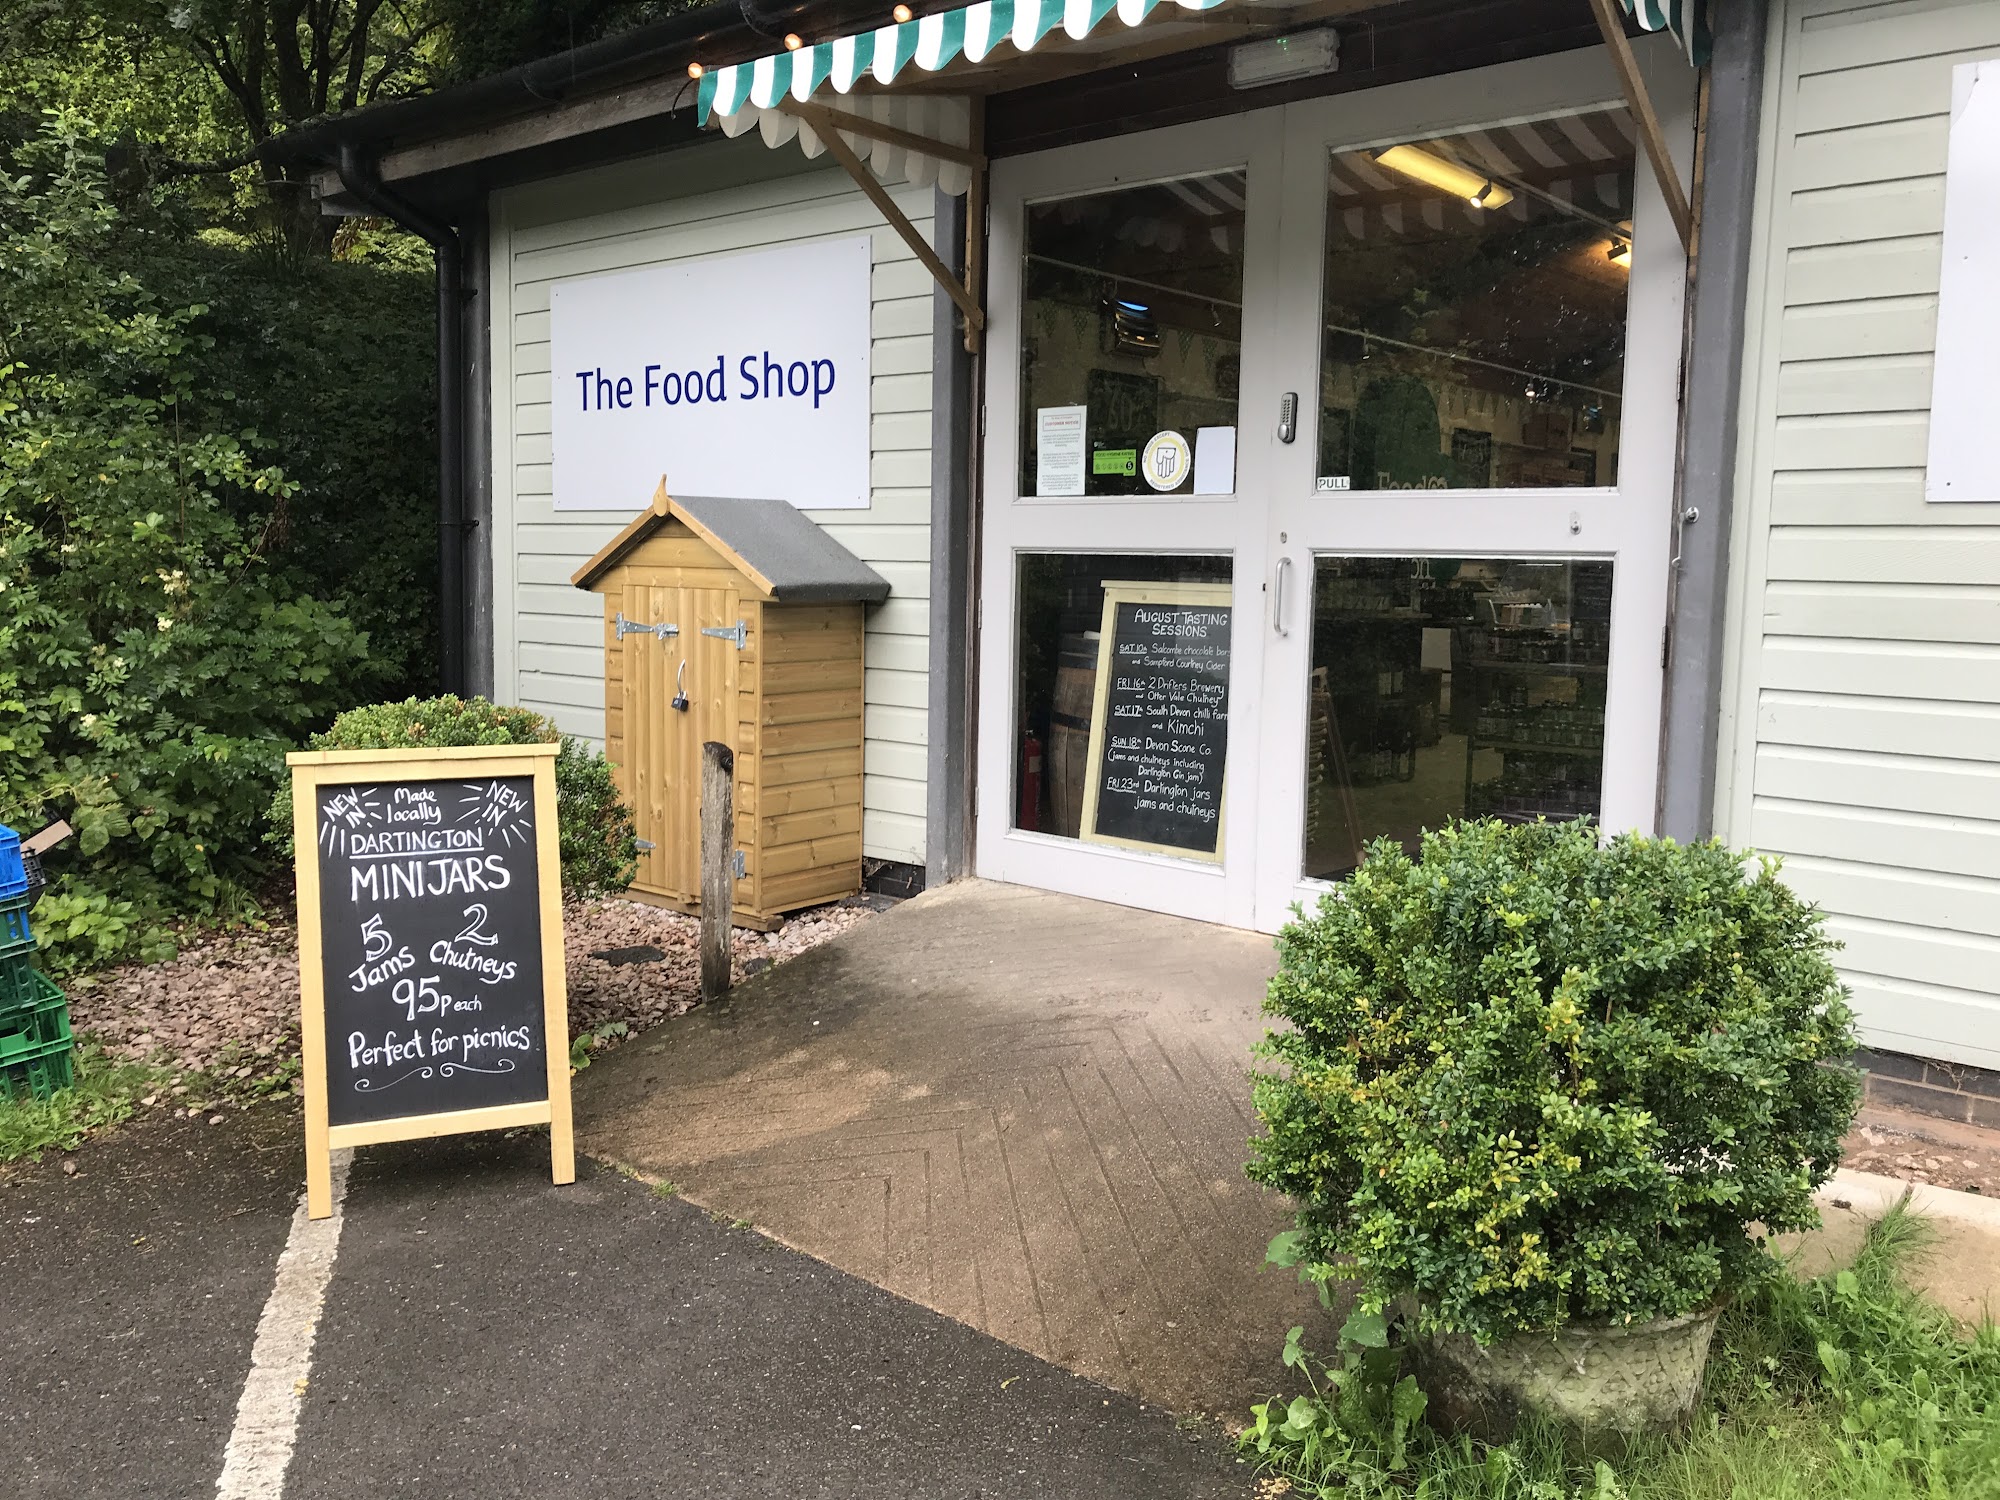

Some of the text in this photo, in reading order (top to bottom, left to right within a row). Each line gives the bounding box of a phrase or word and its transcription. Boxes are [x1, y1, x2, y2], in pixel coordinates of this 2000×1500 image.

[576, 351, 836, 411] The Food Shop
[1153, 432, 1170, 442] EXCEPT
[1127, 461, 1133, 470] 5
[1318, 478, 1347, 489] PULL
[1134, 608, 1228, 626] AUGUST TASTING
[1151, 623, 1208, 638] SESSIONS
[1119, 643, 1135, 652] SAT
[1151, 642, 1183, 655] Salcombe
[1183, 645, 1214, 656] chocolate
[1143, 656, 1175, 668] Sampford
[1176, 658, 1204, 673] Courtney
[1206, 660, 1226, 670] Cider
[1117, 677, 1131, 688] FRI
[1148, 676, 1156, 689] 2
[1157, 677, 1188, 691] Drifters
[1190, 678, 1225, 700] Brewery
[1147, 691, 1167, 701] Otter
[1169, 691, 1185, 702] Vale
[1186, 692, 1220, 708] Chutney
[1146, 704, 1169, 716] South
[1170, 704, 1191, 717] Devon
[1193, 707, 1211, 719] chilli
[1167, 719, 1205, 736] Kimchi
[1111, 736, 1127, 746] SUN
[1145, 737, 1169, 752] Devon
[1171, 740, 1196, 753] Scone
[1107, 748, 1126, 762] (jams
[1140, 753, 1171, 768] chutneys
[1173, 758, 1205, 774] including
[1138, 765, 1204, 785] Dartington Gin jam)
[394, 787, 437, 804] Made
[486, 780, 528, 813] NEW
[1107, 776, 1120, 789] FRI
[1144, 780, 1188, 799] Dartington
[1190, 787, 1211, 801] jars
[323, 787, 359, 822] NEW
[387, 802, 442, 826] locally
[482, 802, 508, 827] IN
[1134, 796, 1216, 822] jams and chutneys
[346, 805, 367, 829] IN
[351, 826, 483, 854] DARTINGTON
[351, 855, 511, 901] MINI JARS
[454, 903, 499, 946] 2
[361, 913, 393, 962] 5
[348, 946, 416, 992] Jams
[429, 940, 518, 984] Chutneys
[453, 994, 482, 1011] each
[347, 1025, 530, 1069] Perfect for picnics
